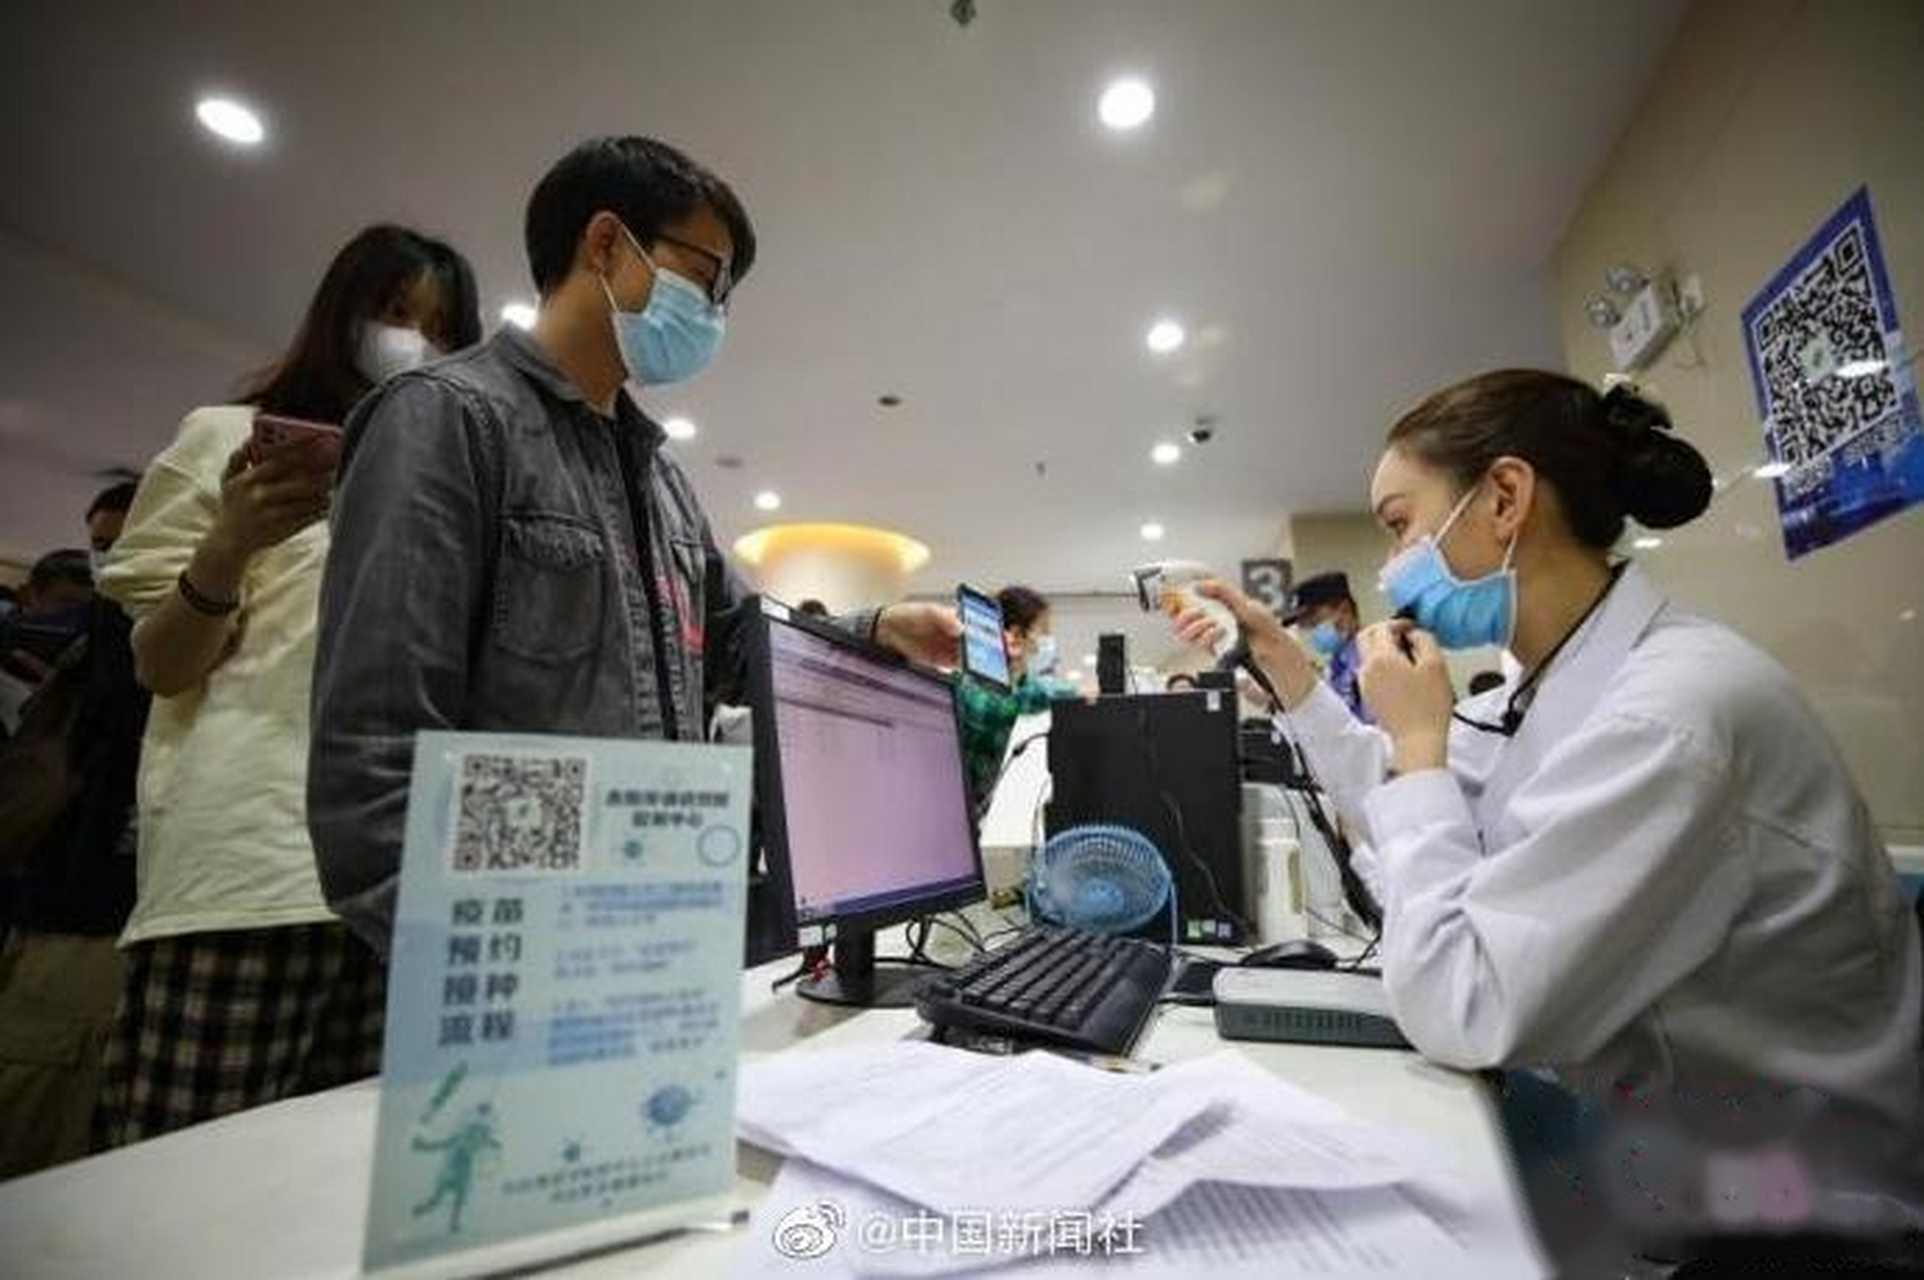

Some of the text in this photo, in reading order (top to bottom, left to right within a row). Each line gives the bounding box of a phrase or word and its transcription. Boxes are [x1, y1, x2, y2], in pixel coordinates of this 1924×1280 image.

[1250, 567, 1284, 611] 3
[453, 898, 524, 926] 疫苗
[449, 932, 522, 966] 预约
